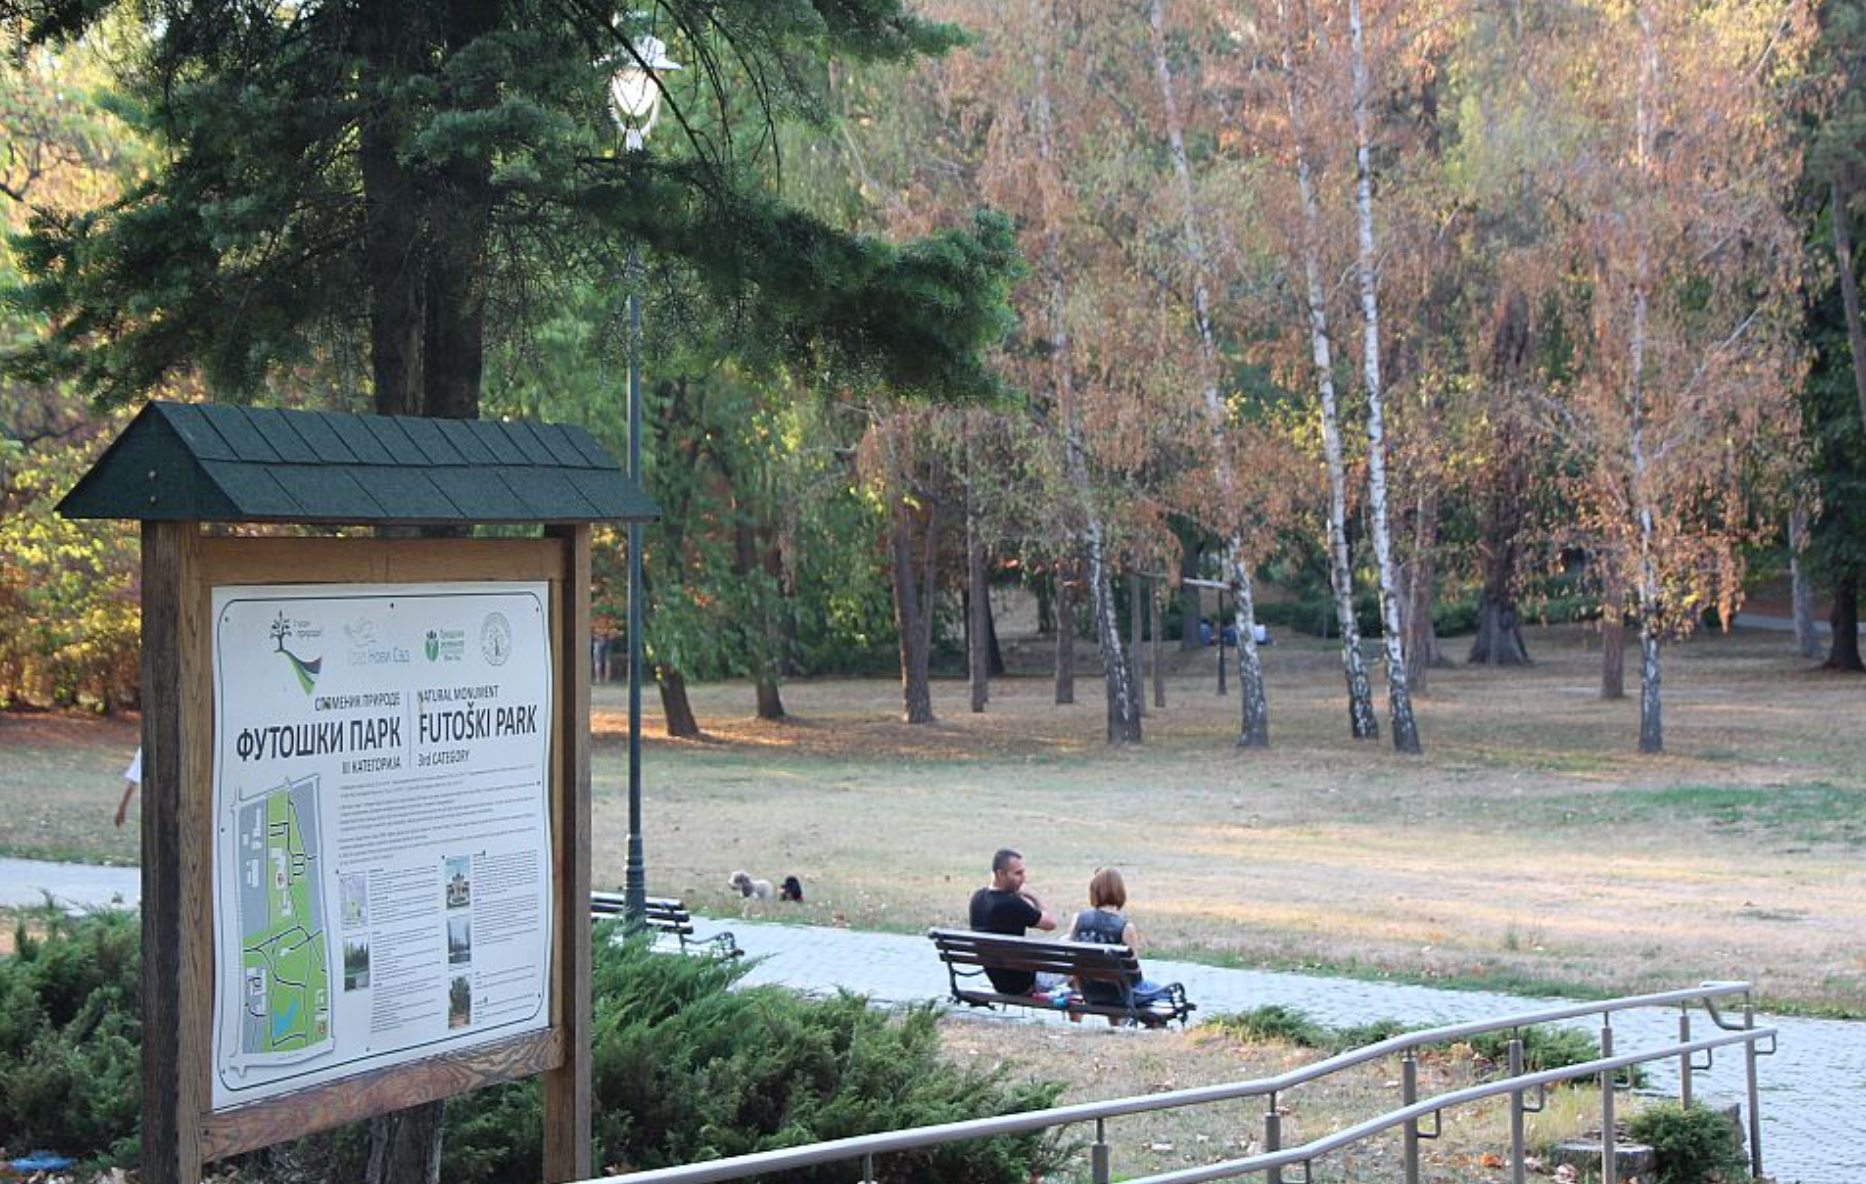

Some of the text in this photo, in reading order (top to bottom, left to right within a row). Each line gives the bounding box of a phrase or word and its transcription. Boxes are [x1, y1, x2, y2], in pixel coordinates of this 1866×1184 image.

[363, 691, 400, 709] ПРИРОДЕ
[417, 685, 500, 703] NATURAL MONUMENT
[419, 700, 537, 744] FUTOŠKI PARK
[236, 715, 402, 761] ФУТОШКИ ПАРК
[352, 756, 402, 775] КАТЕГОРИЈА
[418, 749, 470, 767] 3rd CATEGORY
